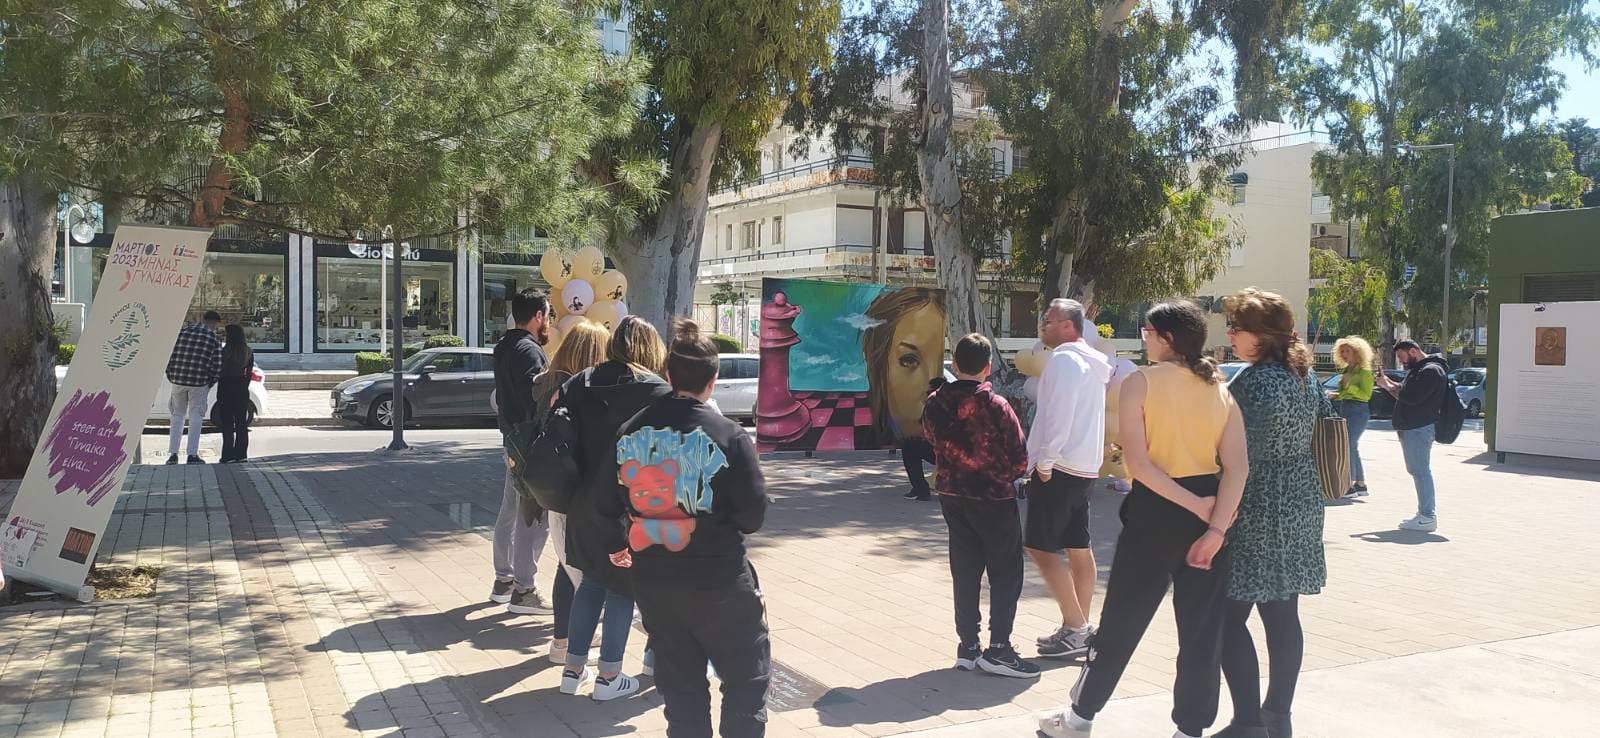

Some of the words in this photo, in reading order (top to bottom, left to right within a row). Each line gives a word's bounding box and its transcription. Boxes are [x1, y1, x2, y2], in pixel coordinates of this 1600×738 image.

[115, 242, 160, 256] ΜΑΡΤΙΟΣ
[112, 254, 137, 267] 2023
[137, 257, 181, 272] ΜΗΝΑΣ
[131, 269, 193, 288] ΓΥΝΑΙΚΑΣ
[97, 427, 114, 438] art
